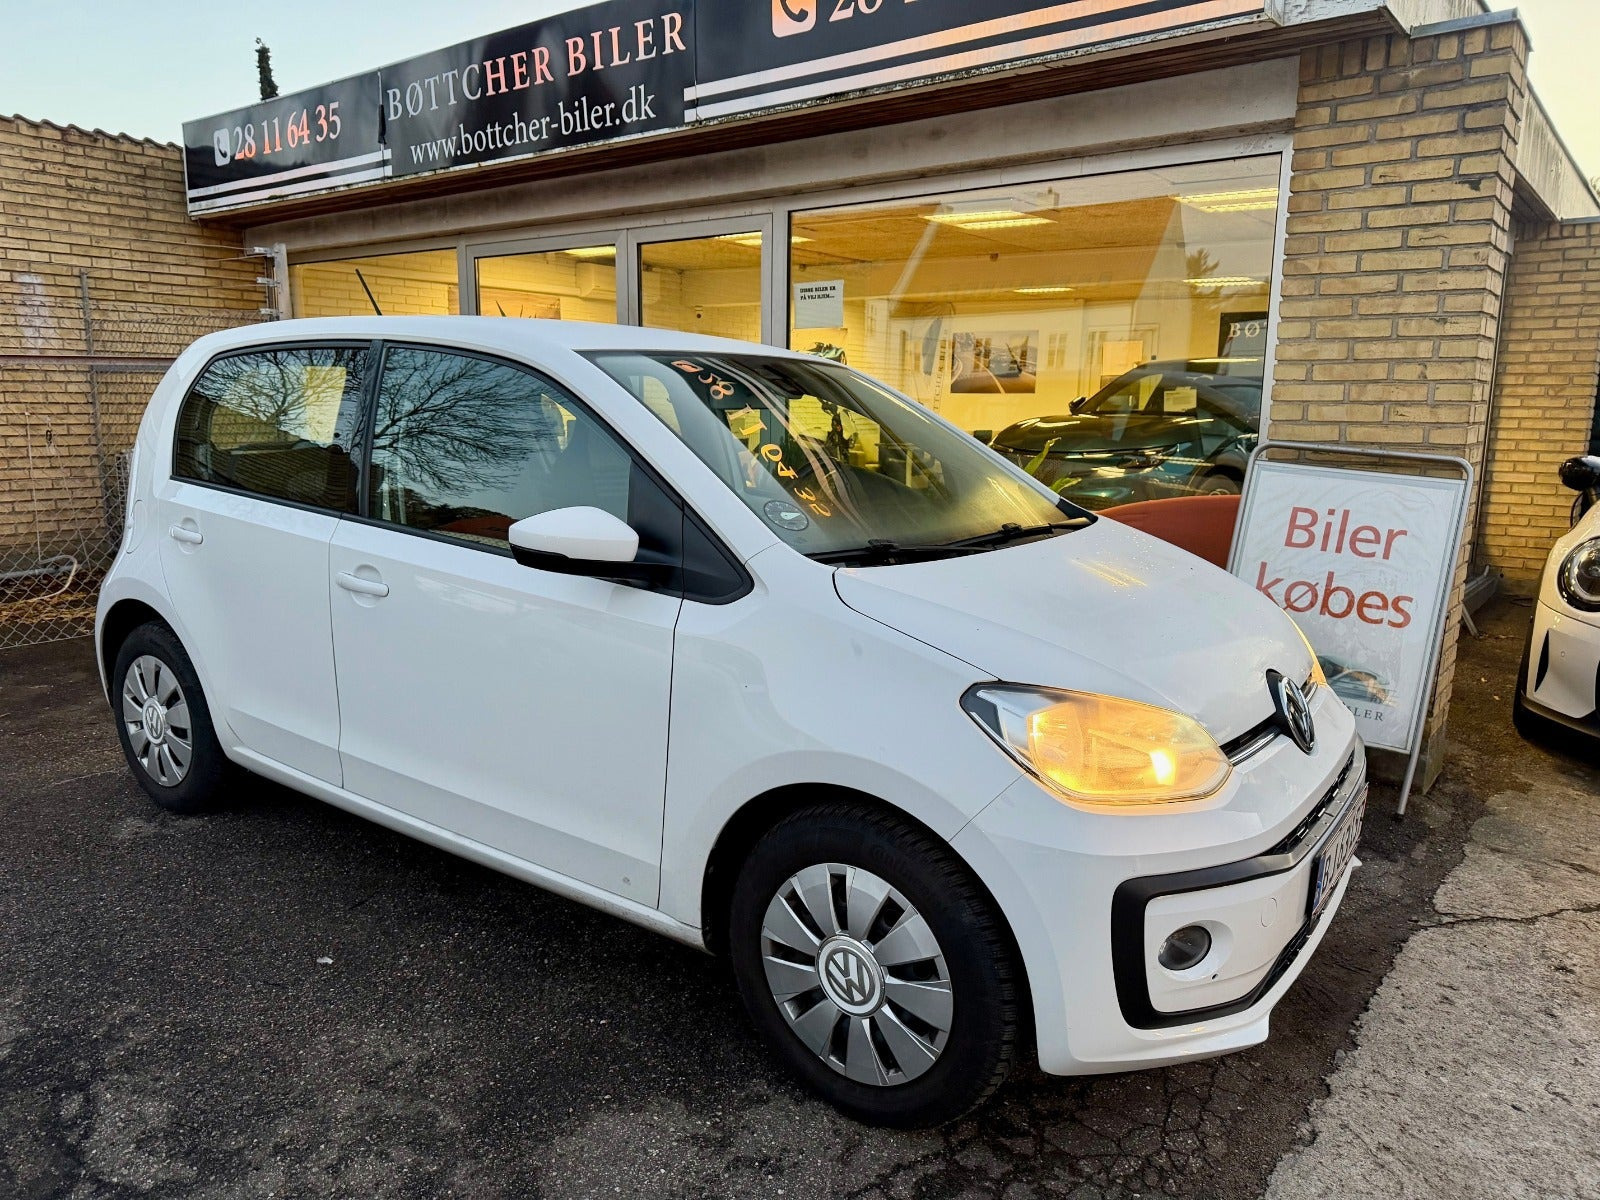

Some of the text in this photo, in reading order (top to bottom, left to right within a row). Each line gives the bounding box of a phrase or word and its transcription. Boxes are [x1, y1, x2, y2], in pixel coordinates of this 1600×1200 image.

[387, 12, 686, 121] BØTTCHER BILER
[233, 101, 341, 160] 28 11 64 35
[410, 84, 657, 165] www.bottcher-biler.dk
[1228, 321, 1268, 338] BØ
[1284, 506, 1408, 560] Biler
[1255, 561, 1414, 628] købes
[1343, 702, 1384, 722] LER
